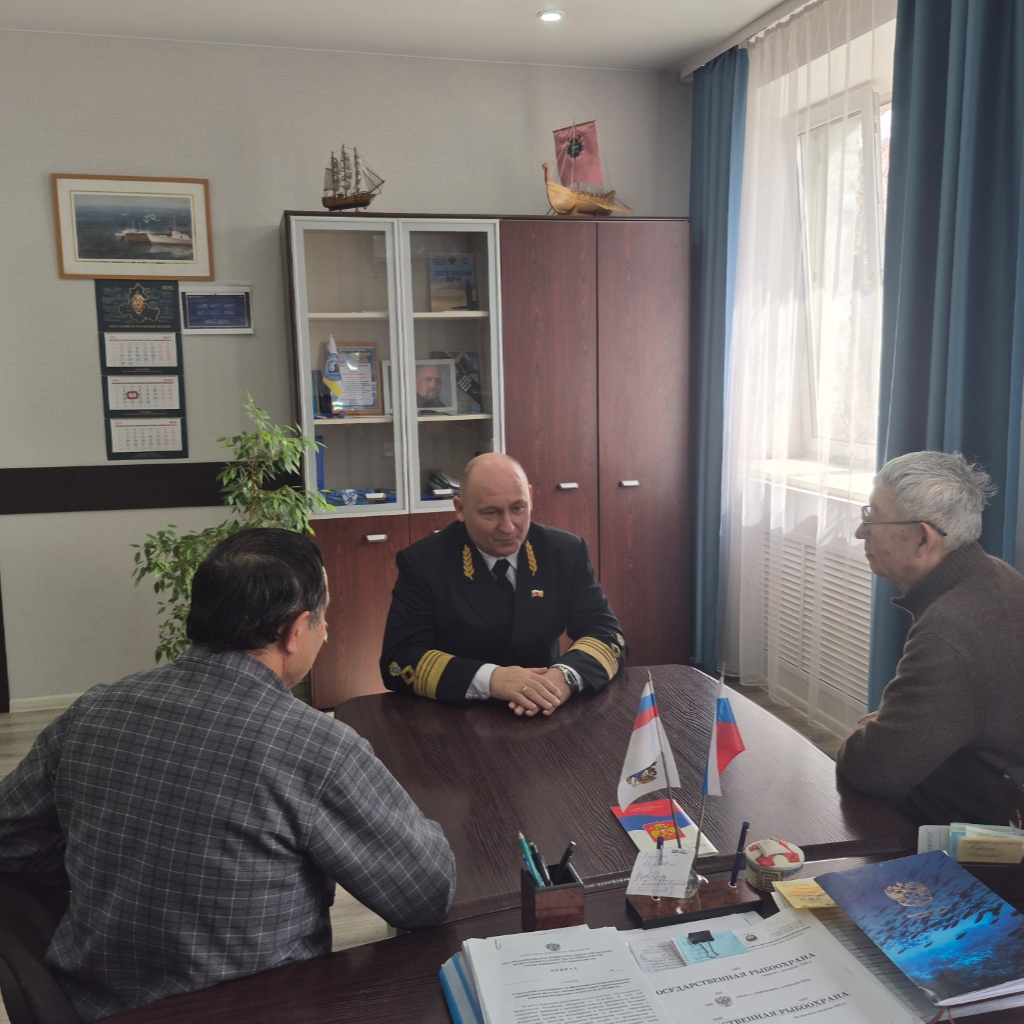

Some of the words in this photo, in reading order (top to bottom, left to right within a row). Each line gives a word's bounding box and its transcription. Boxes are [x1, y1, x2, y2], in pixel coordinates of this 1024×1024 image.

[655, 972, 748, 996] ОСУДАРСТВЕННАЯ
[748, 952, 816, 976] РЫБООХРАНА
[778, 991, 850, 1015] РЫБООХРАНА
